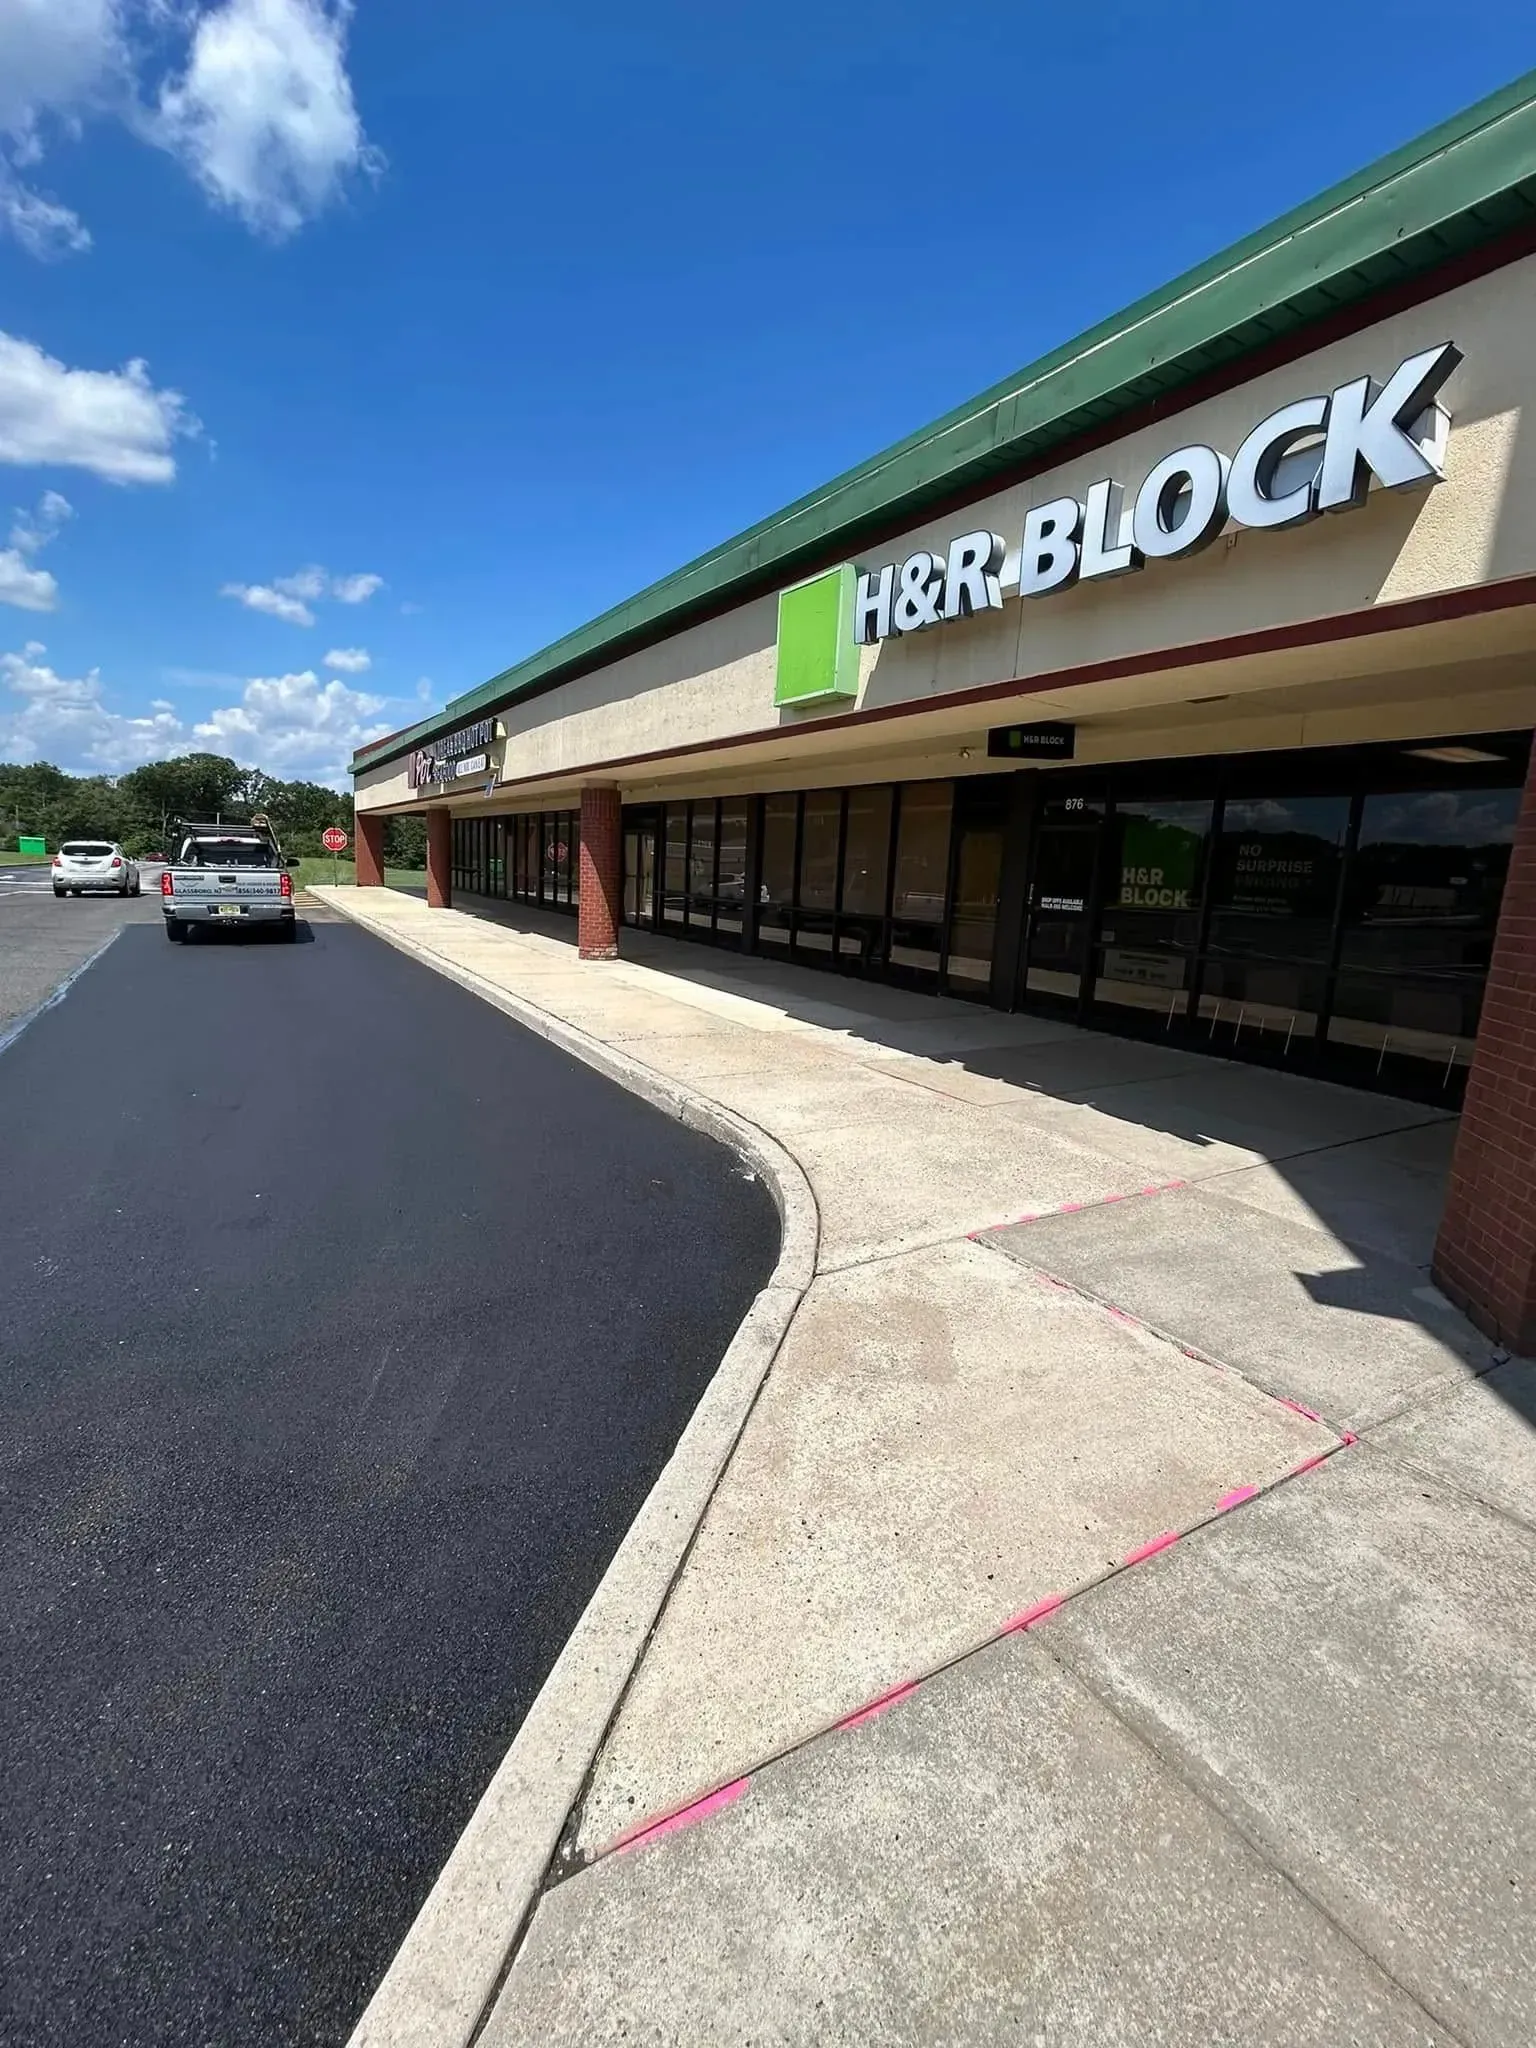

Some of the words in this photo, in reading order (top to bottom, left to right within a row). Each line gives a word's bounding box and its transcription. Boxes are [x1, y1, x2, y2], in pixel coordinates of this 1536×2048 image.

[854, 530, 1002, 645] H&R
[1020, 340, 1459, 597] BLOCK
[480, 717, 494, 745] POT
[1023, 735, 1039, 744] H&R
[1040, 736, 1065, 745] BLOCK
[1065, 798, 1084, 810] 876
[325, 834, 345, 843] STOP
[1239, 844, 1263, 857] NO
[1236, 859, 1313, 873] SURPRISE
[1121, 866, 1164, 886] H&R
[1120, 886, 1189, 907] BLOCK
